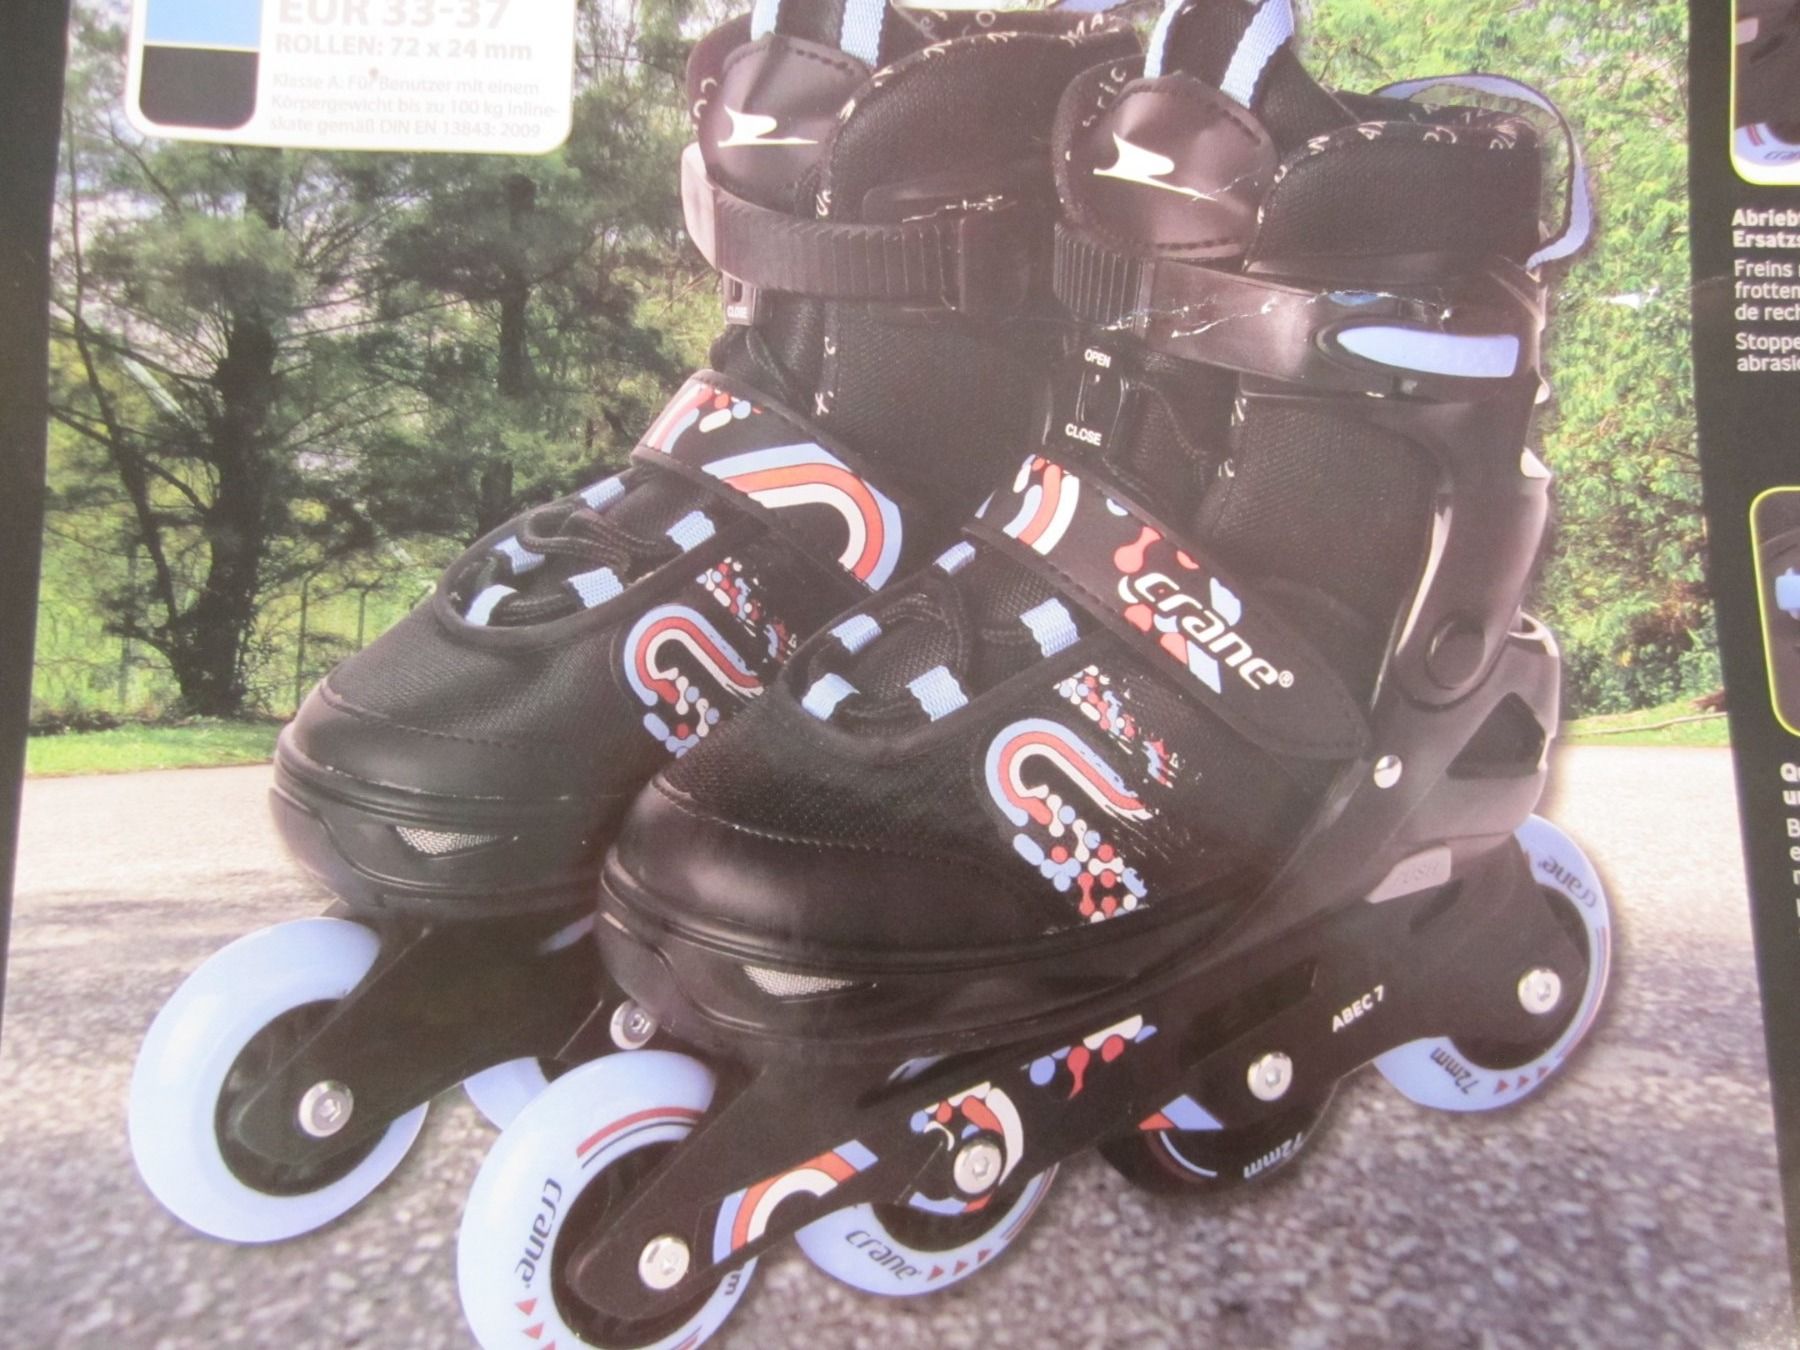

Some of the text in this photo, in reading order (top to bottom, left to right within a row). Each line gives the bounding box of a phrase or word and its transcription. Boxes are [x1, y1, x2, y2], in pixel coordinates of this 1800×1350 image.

[274, 33, 533, 61] ROLLEN: 72 x 24 mm
[272, 72, 323, 90] Klasse
[379, 75, 450, 93] Benutzer
[456, 77, 484, 93] mit
[487, 79, 540, 96] einem
[271, 94, 394, 114] Körpergewicht
[397, 97, 421, 113] bis
[425, 100, 445, 114] zu
[451, 99, 480, 115] 100
[484, 100, 503, 118] kg
[270, 115, 313, 132] skate
[317, 117, 375, 136] gemäß
[379, 118, 410, 135] DIN
[414, 119, 437, 136] EN
[500, 121, 542, 138] 2009
[1734, 260, 1793, 278] Freins
[1735, 303, 1758, 321] de
[1084, 348, 1112, 368] OPEN
[1065, 423, 1102, 446] CLOSE
[1332, 984, 1385, 1033] ABEC 7
[1430, 1047, 1480, 1095] 72mm
